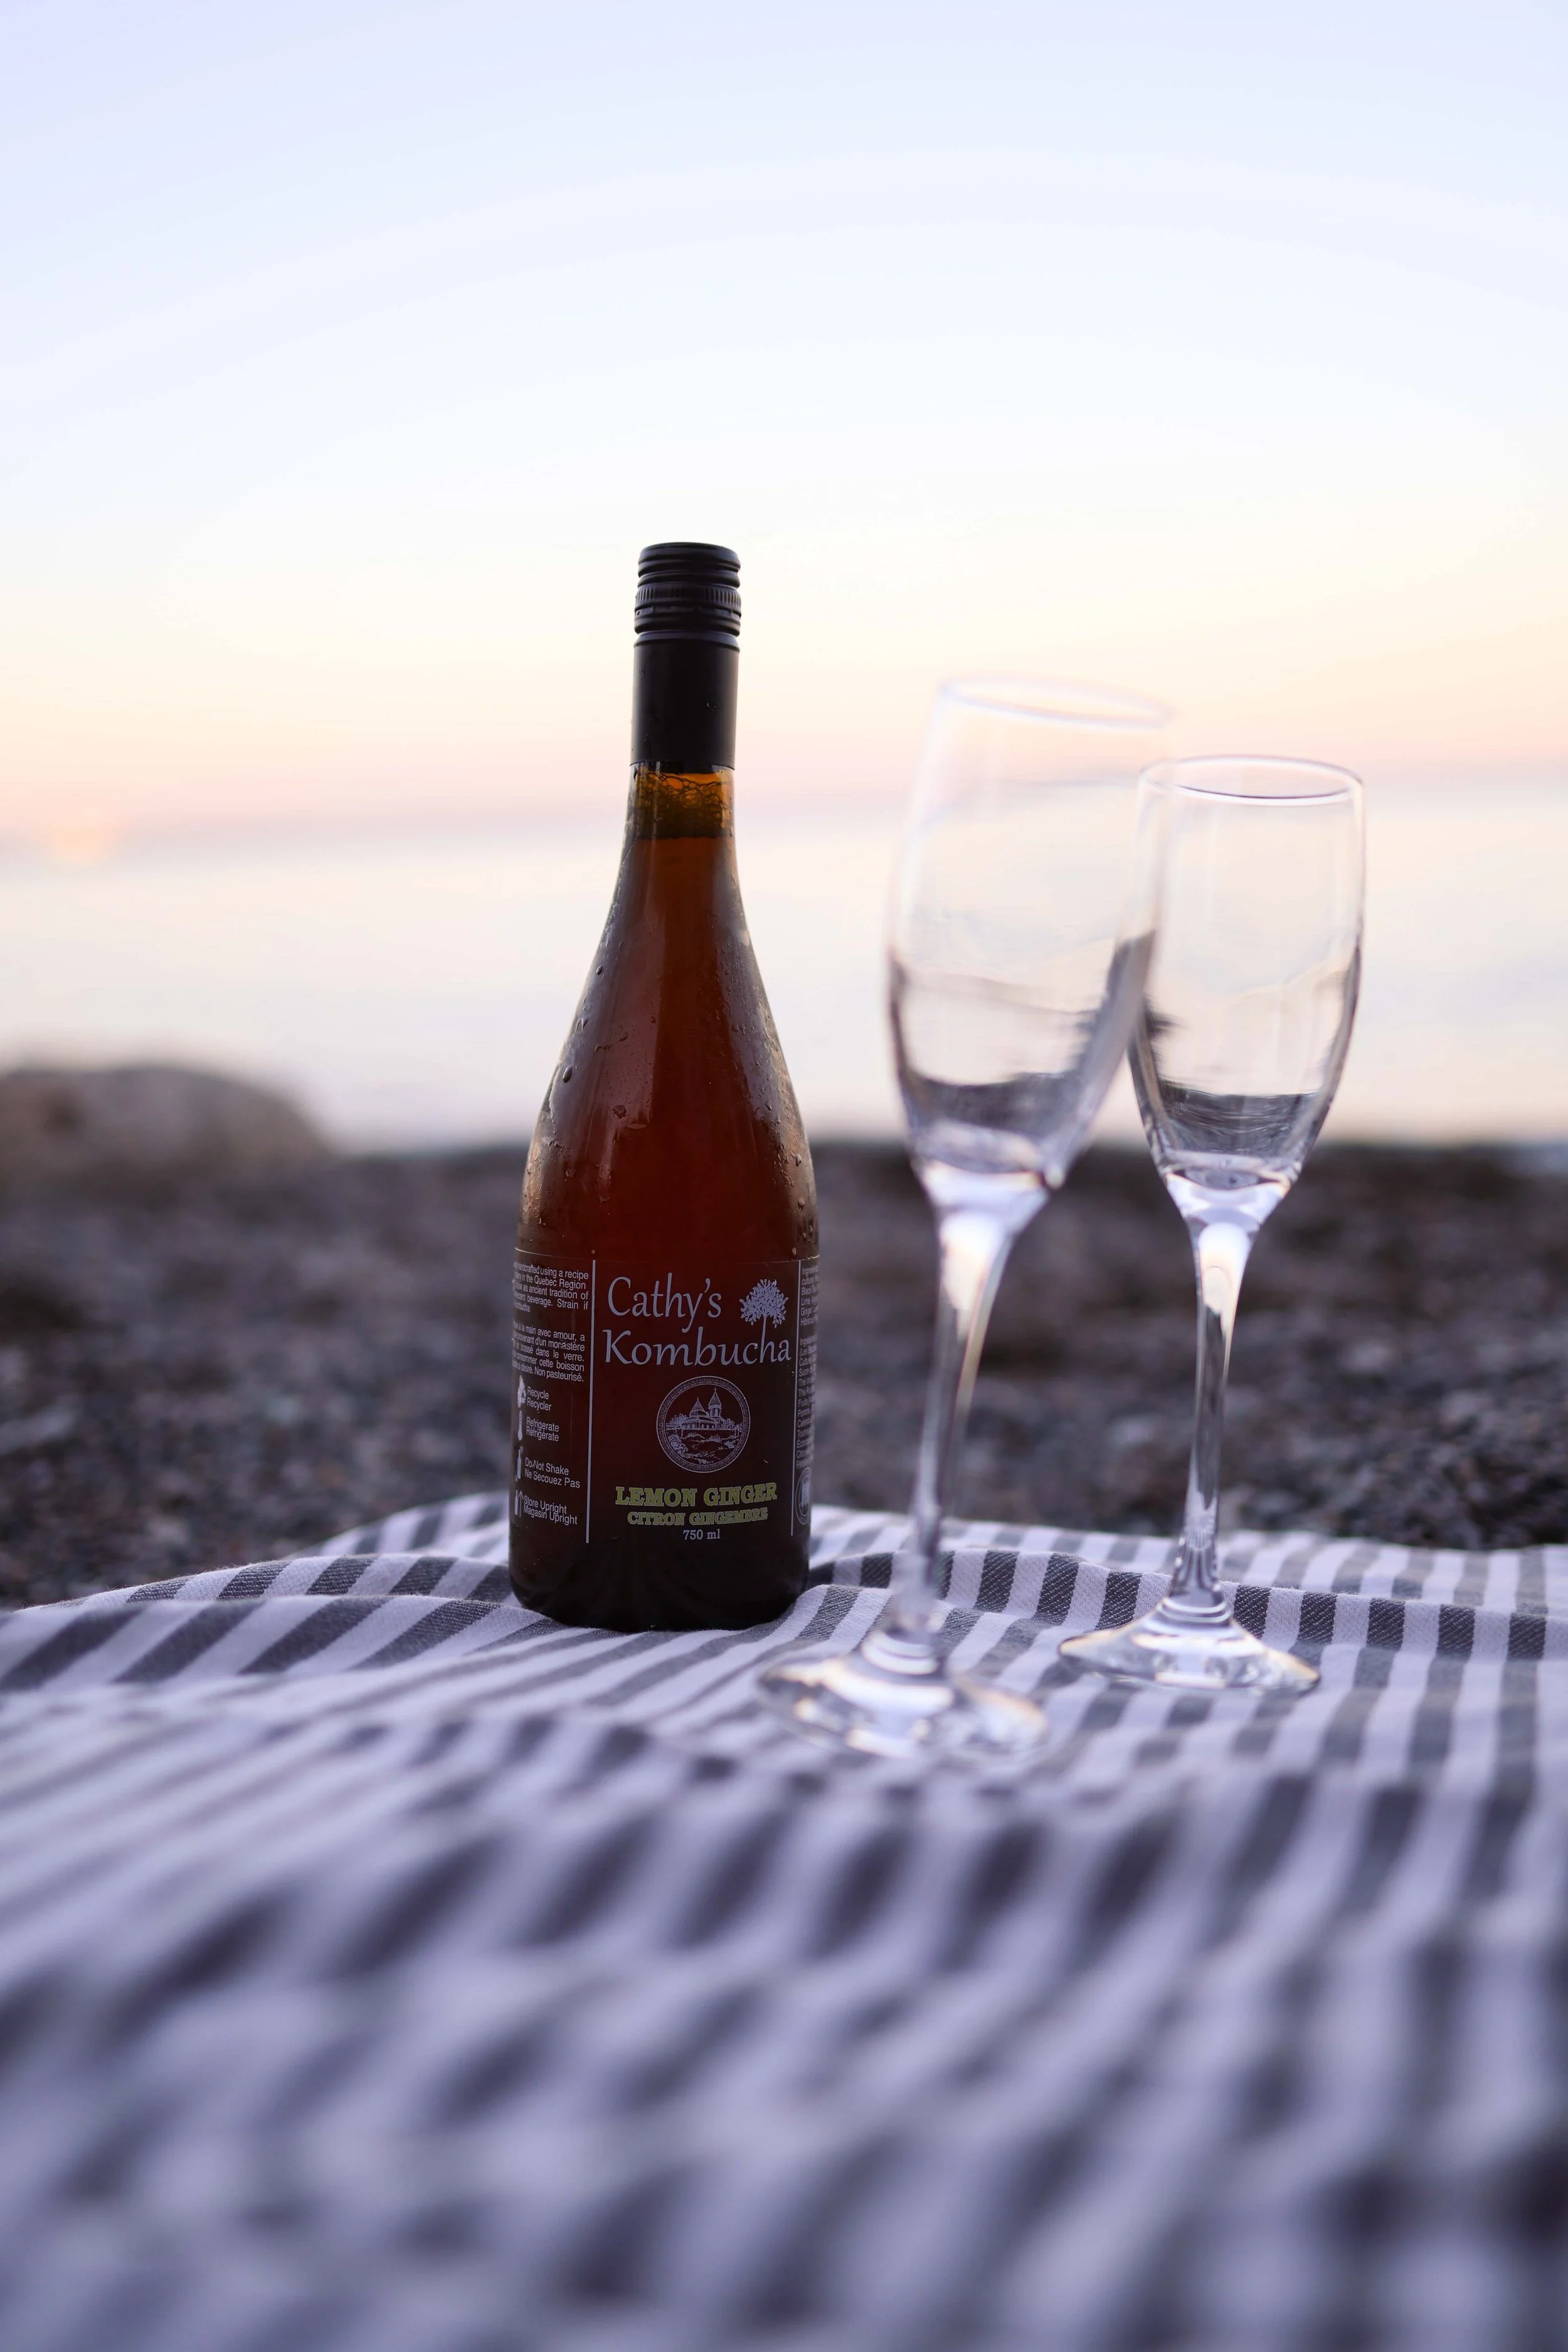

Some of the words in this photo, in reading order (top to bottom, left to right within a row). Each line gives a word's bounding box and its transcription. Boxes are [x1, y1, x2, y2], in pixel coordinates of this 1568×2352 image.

[540, 1267, 557, 1278] using
[565, 1270, 588, 1281] recipe
[534, 1275, 557, 1286] Quebec
[559, 1279, 586, 1290] Region
[529, 1286, 547, 1295] ancient
[549, 1288, 577, 1298] tradition
[581, 1291, 588, 1300] of
[527, 1294, 553, 1308] beverage.
[557, 1298, 578, 1309] Strain
[583, 1301, 588, 1310] if
[608, 1273, 721, 1333] Cathy's
[526, 1325, 536, 1334] main
[553, 1332, 576, 1342] amour,
[535, 1337, 546, 1346] d'un
[548, 1341, 585, 1351] monastère
[603, 1327, 791, 1366] Kombucha
[536, 1347, 549, 1357] dans
[553, 1350, 559, 1359] le
[563, 1353, 584, 1361] verre.
[539, 1359, 553, 1367] cette
[556, 1360, 584, 1371] boisson
[534, 1366, 545, 1376] Non
[546, 1370, 583, 1382] pasteurisé.
[527, 1386, 549, 1399] Recycle
[527, 1397, 551, 1411] Recycler
[527, 1416, 559, 1432] Refrigerate
[525, 1458, 531, 1468] Do
[533, 1460, 544, 1471] Not
[546, 1463, 569, 1475] Shake
[525, 1468, 532, 1478] Ne
[533, 1471, 561, 1485] Secouez
[564, 1477, 580, 1488] Pas
[615, 1486, 697, 1507] LEMON
[703, 1482, 778, 1506] GINGER
[524, 1495, 538, 1508] Store
[541, 1500, 566, 1515] Upright
[524, 1504, 547, 1518] Magasin
[549, 1512, 577, 1525] Upright
[627, 1512, 686, 1525] CITRON
[689, 1507, 768, 1525] GINGEMBRE
[683, 1529, 703, 1540] 750
[706, 1528, 721, 1539] ml
